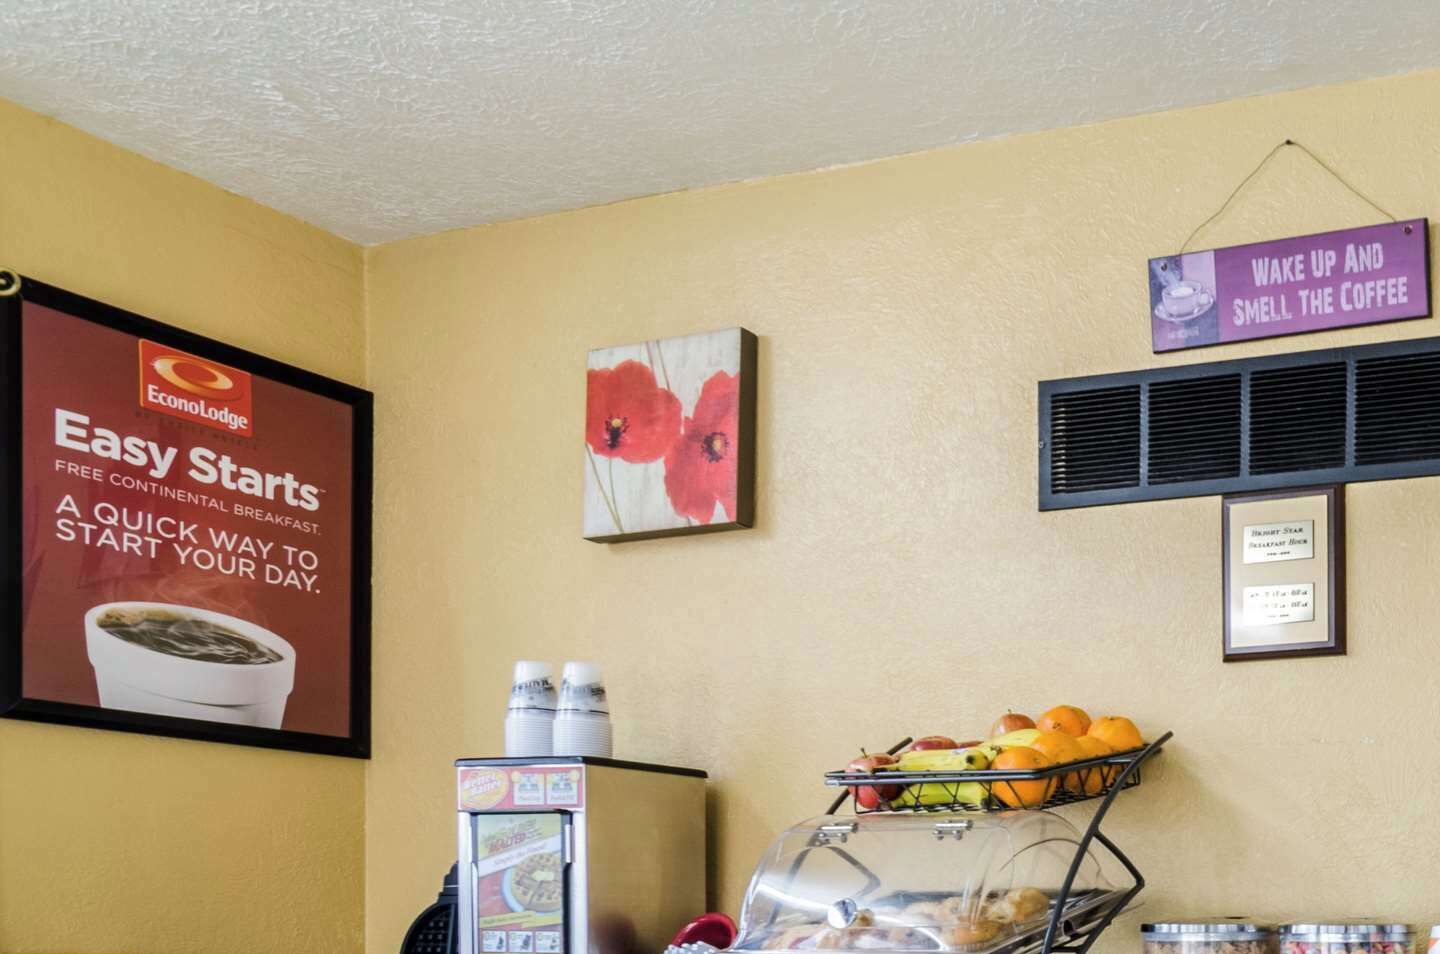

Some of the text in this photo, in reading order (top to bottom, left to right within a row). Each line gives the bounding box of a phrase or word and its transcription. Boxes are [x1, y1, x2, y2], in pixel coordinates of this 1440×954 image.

[1232, 276, 1408, 327] SMELL THE COFFEE
[1252, 242, 1384, 287] WAKE UP AND
[55, 408, 320, 511] Easy Starts
[55, 459, 321, 536] FREE CONTINENTAL BREAKFAST.
[56, 494, 318, 570] A QUICK WAY TO
[56, 518, 321, 595] START YOUR DAY.
